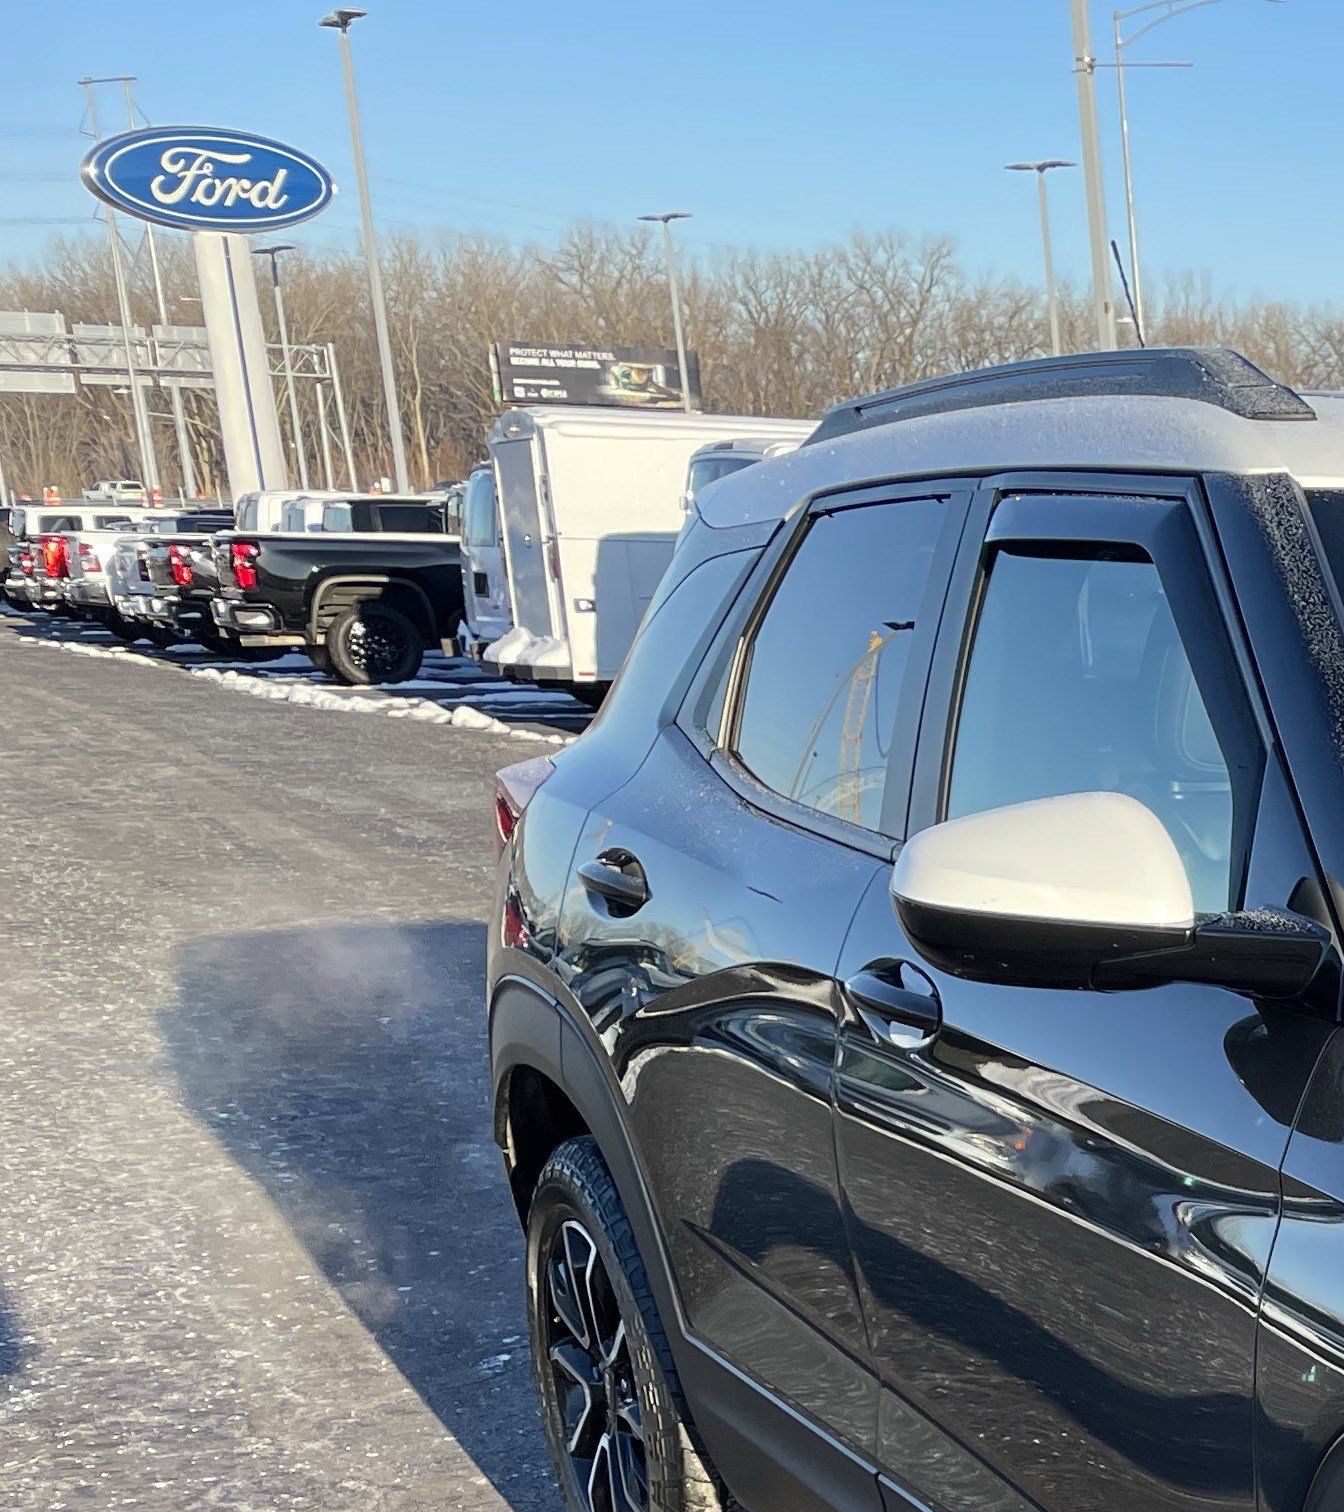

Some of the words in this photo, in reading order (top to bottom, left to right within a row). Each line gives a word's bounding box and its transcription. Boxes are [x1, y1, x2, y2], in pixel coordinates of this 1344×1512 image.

[151, 147, 288, 210] Ford
[509, 348, 548, 358] PROTECT
[549, 349, 574, 359] WHAT
